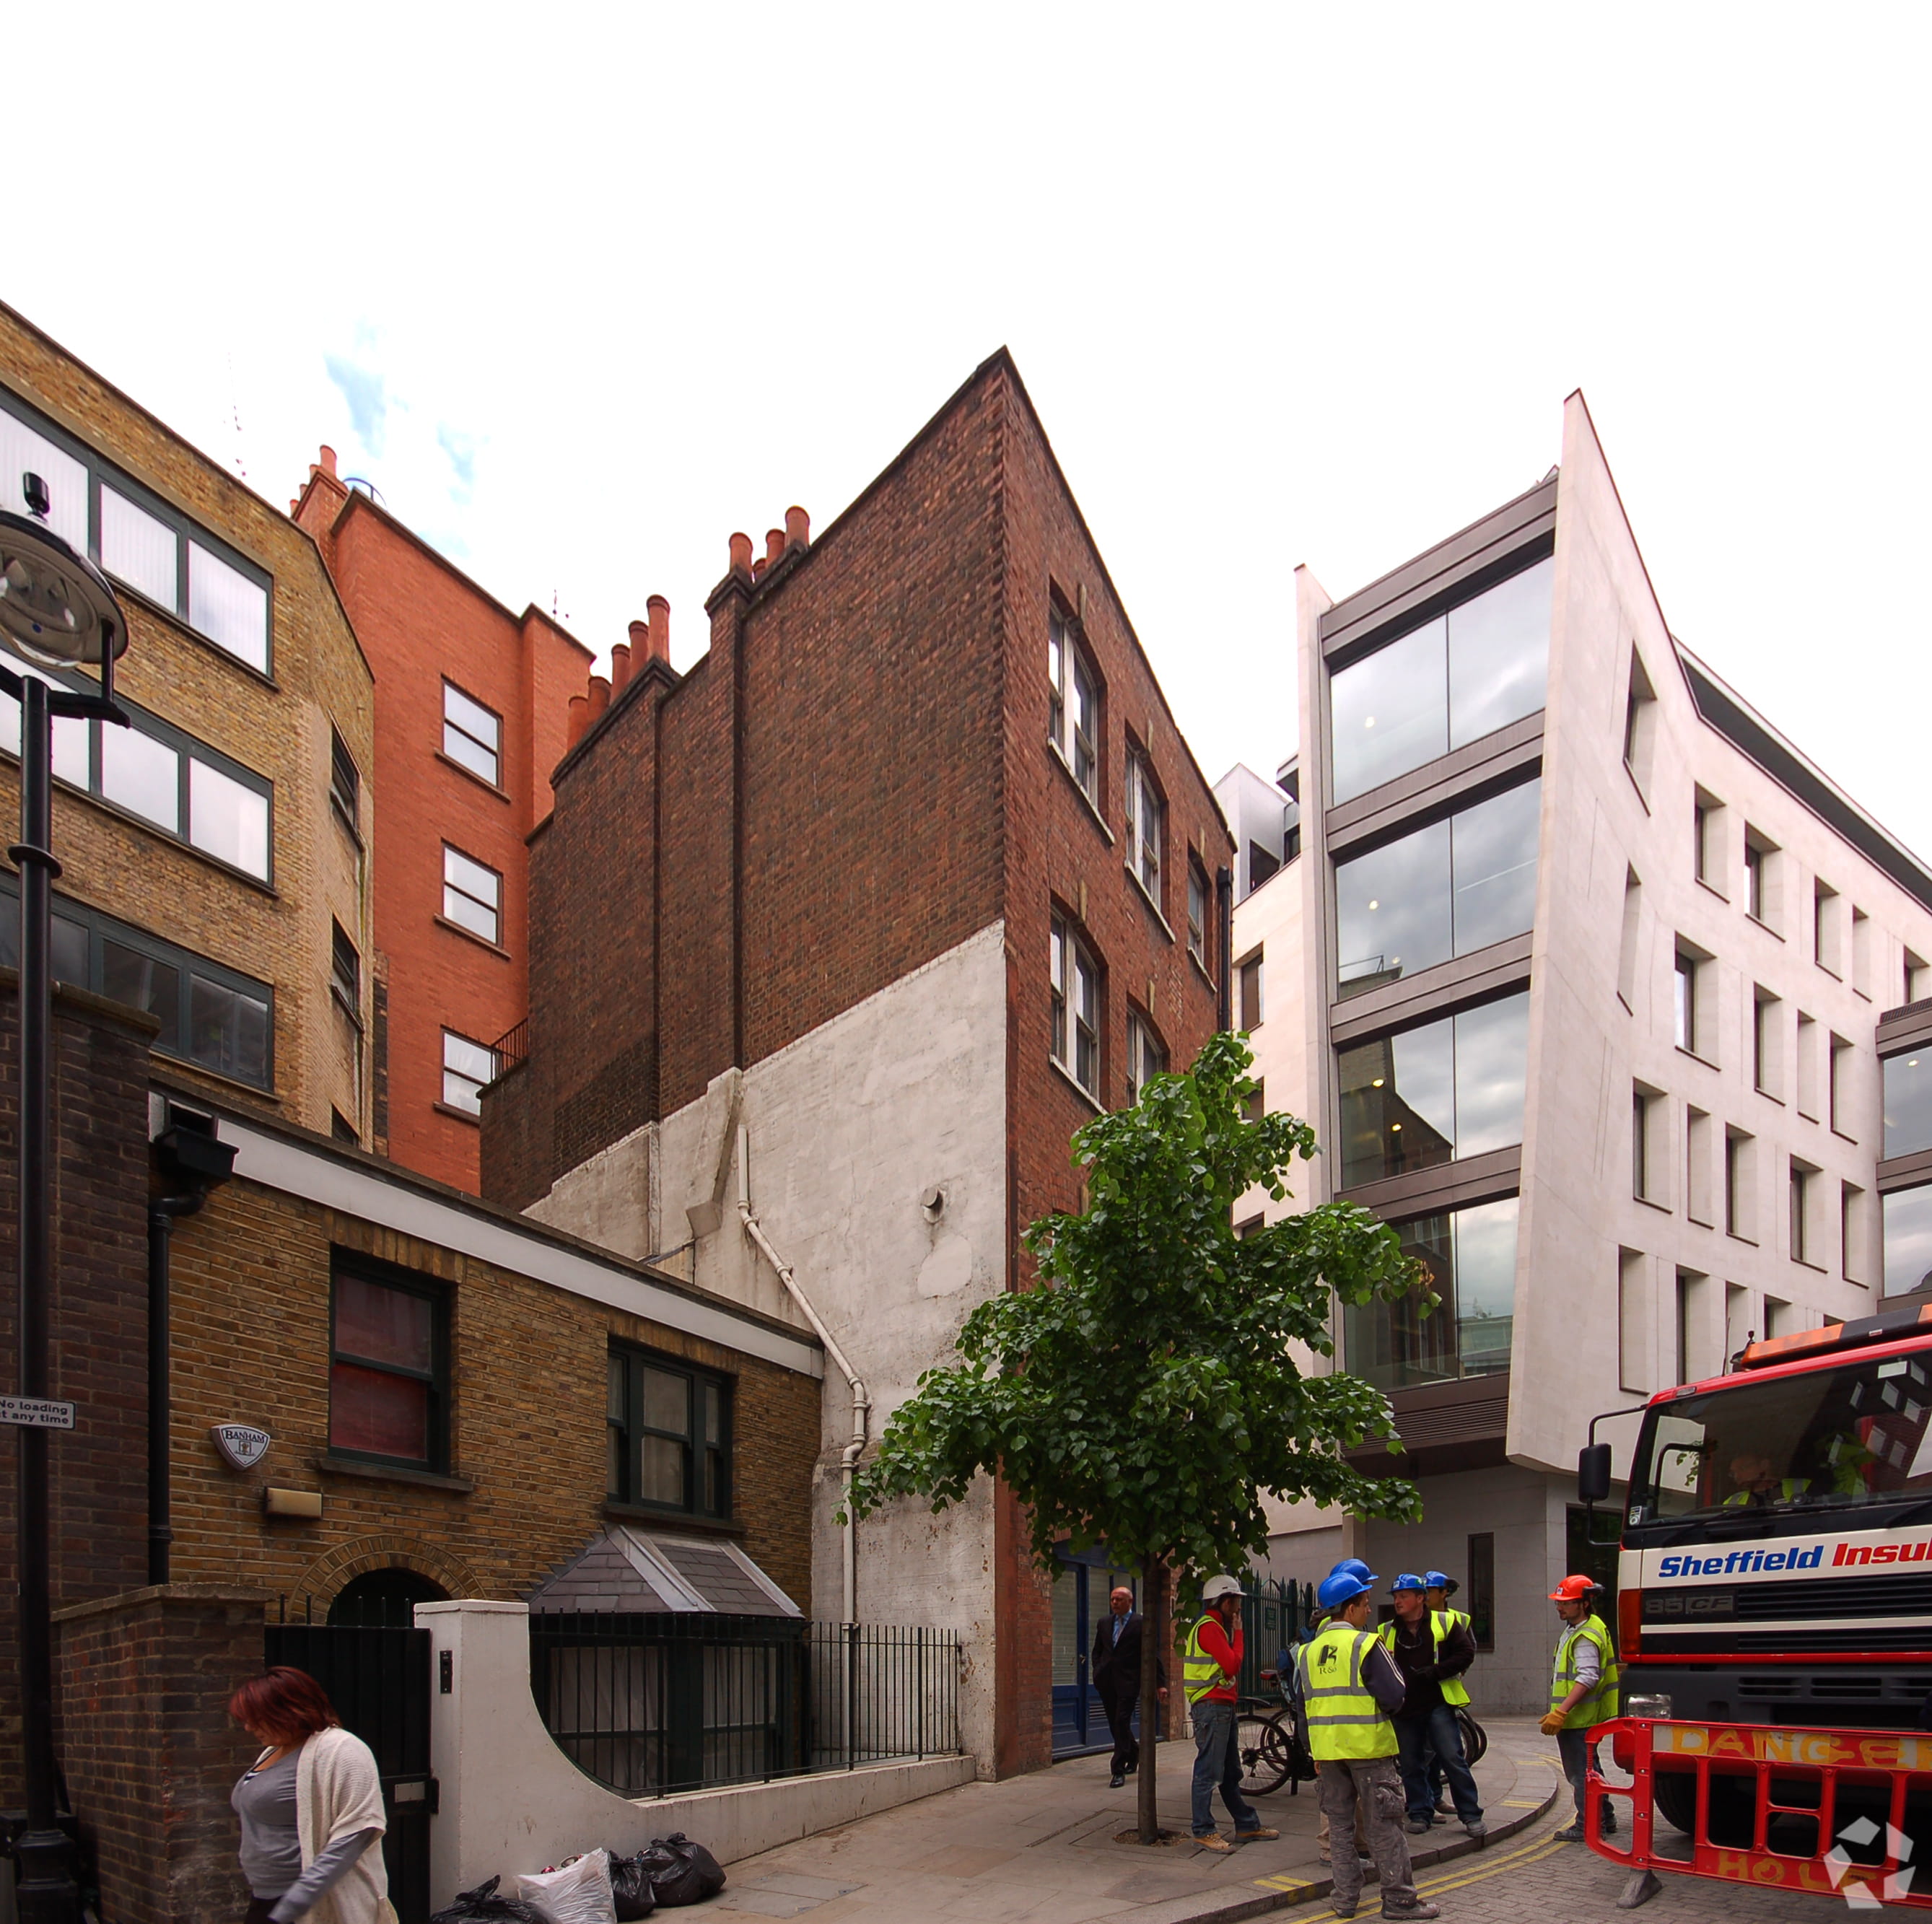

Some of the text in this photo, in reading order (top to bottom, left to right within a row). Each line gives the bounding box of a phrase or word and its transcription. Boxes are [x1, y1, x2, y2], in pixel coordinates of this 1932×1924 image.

[0, 1400, 68, 1415] No loading
[0, 1409, 69, 1425] t any time
[225, 1430, 265, 1443] BANHAM
[1658, 1545, 1824, 1578] Sheffield
